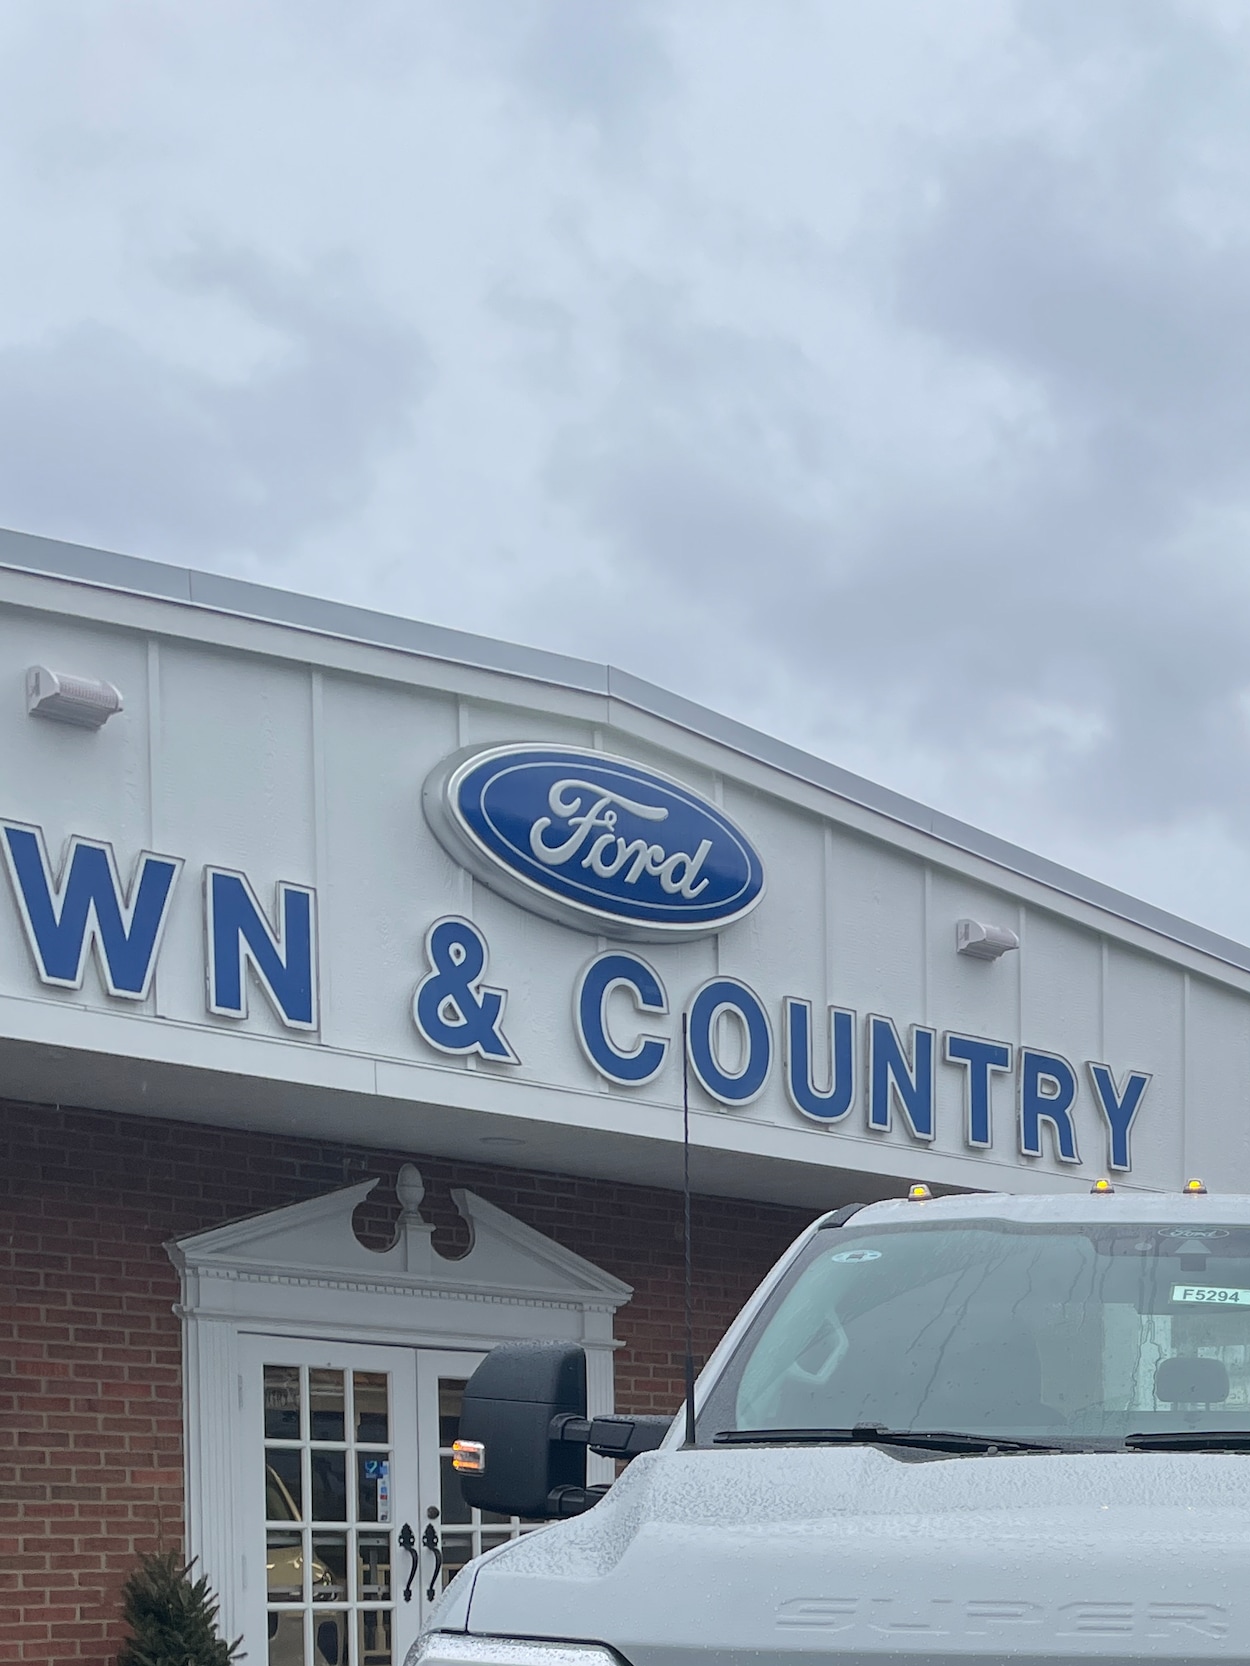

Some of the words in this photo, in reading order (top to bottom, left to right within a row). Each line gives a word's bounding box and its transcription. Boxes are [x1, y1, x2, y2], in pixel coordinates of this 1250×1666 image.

[529, 778, 713, 899] Ford
[0, 817, 318, 1032] WN
[412, 914, 522, 1066] &
[573, 948, 1152, 1172] COUNTRY
[1181, 1288, 1240, 1303] F5294
[774, 1597, 1230, 1638] SUPER
